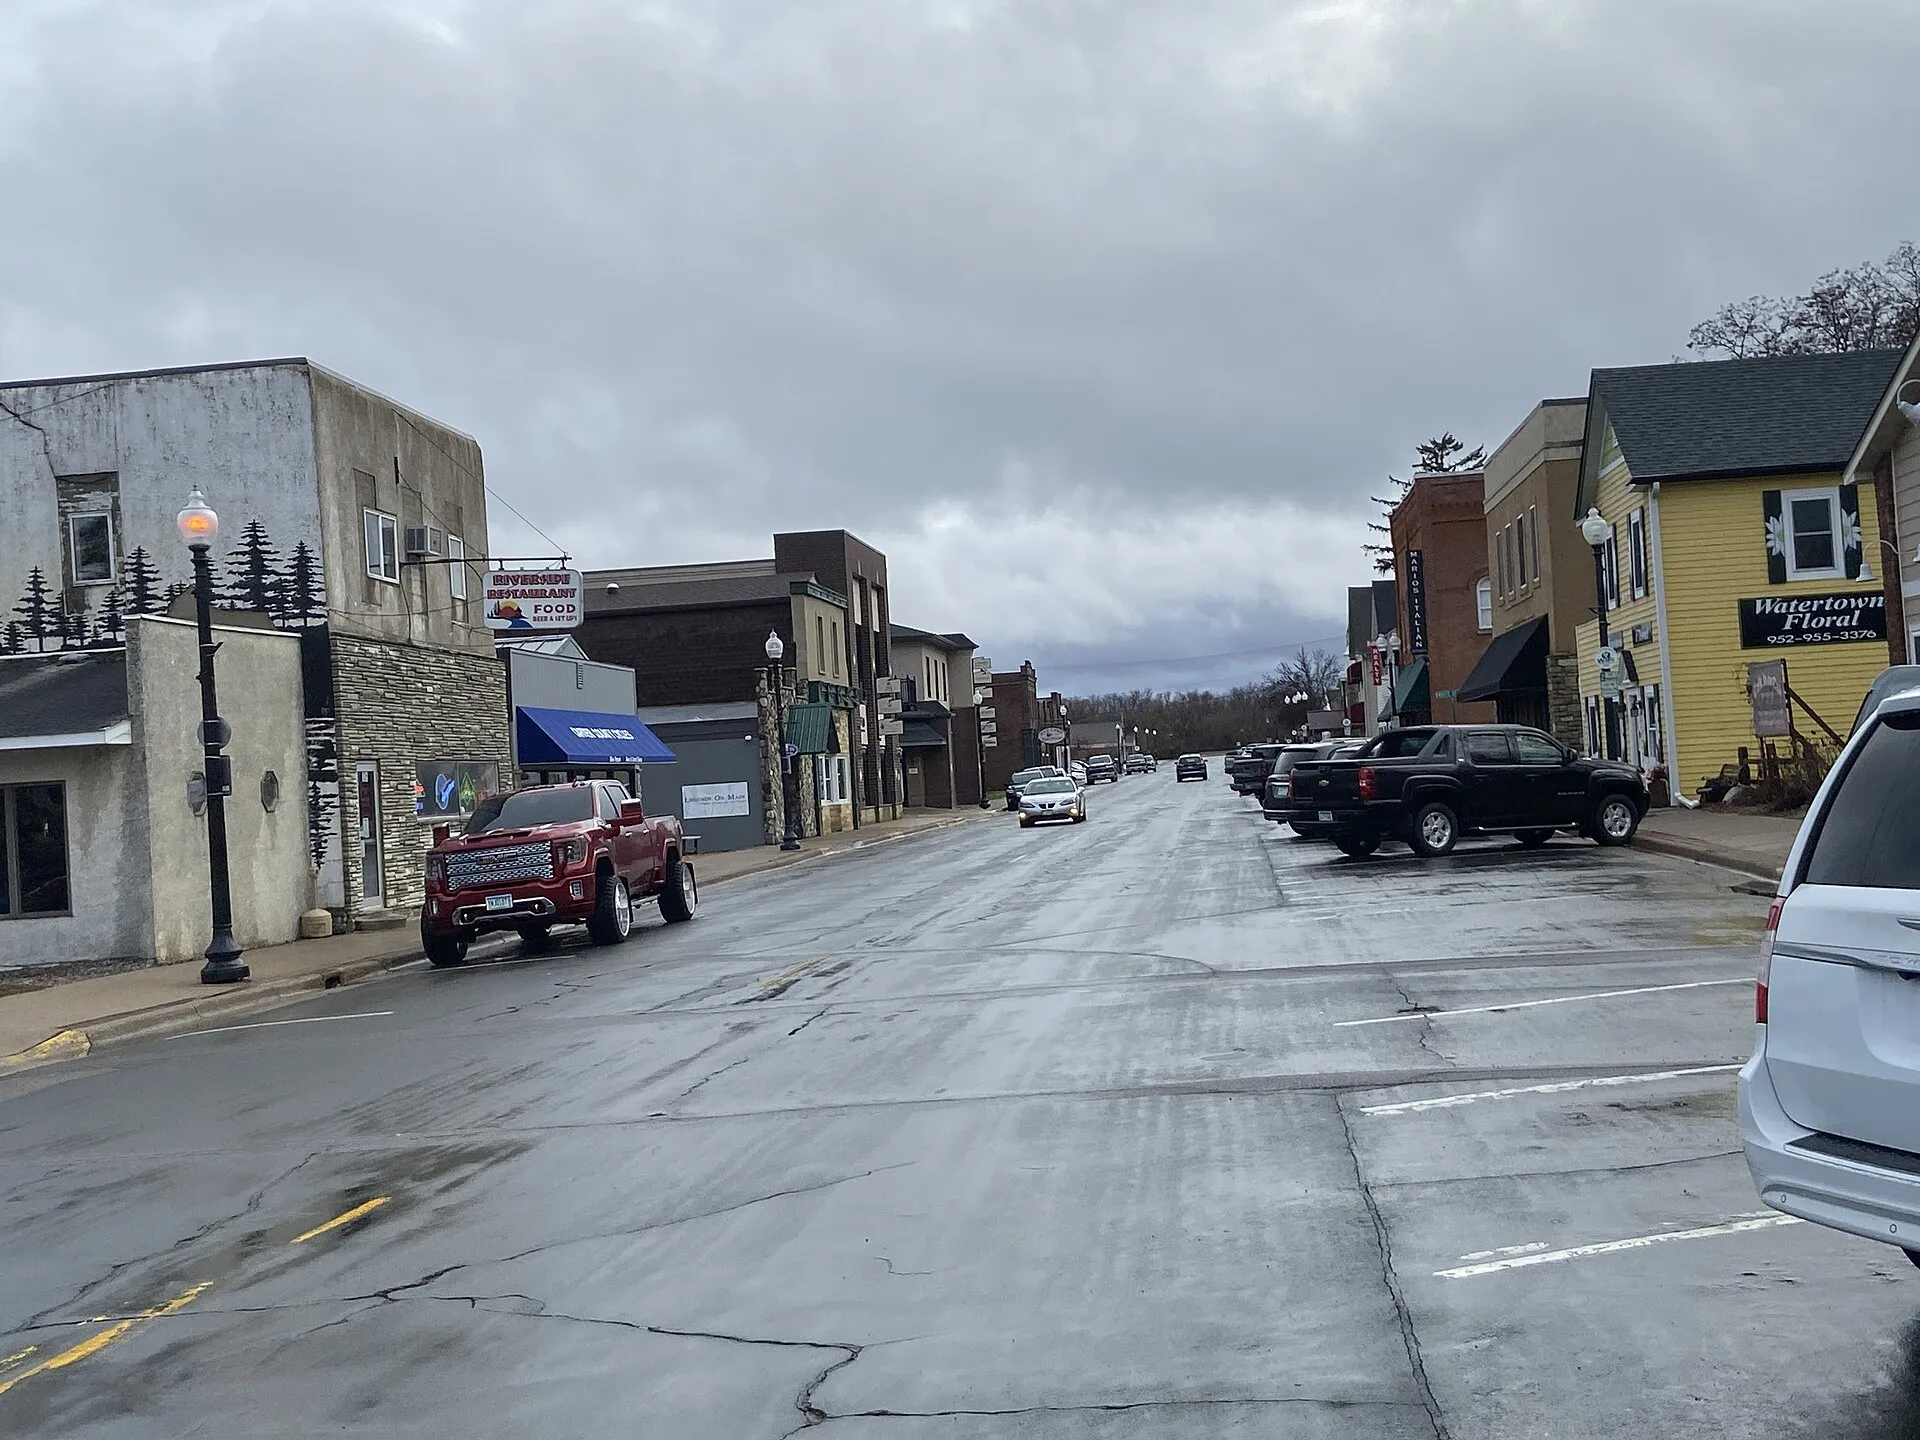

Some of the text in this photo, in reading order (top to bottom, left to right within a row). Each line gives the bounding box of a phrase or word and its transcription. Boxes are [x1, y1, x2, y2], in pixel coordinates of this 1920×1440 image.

[492, 573, 571, 586] RIVERSIDE
[487, 588, 577, 599] RESTAURANT
[533, 604, 576, 614] FOOD
[1754, 596, 1886, 615] Watertown
[1414, 597, 1423, 647] ITALIAN
[1781, 609, 1860, 630] Floral
[1766, 629, 1877, 644] 952-955-3376
[1372, 648, 1380, 684] REALTY
